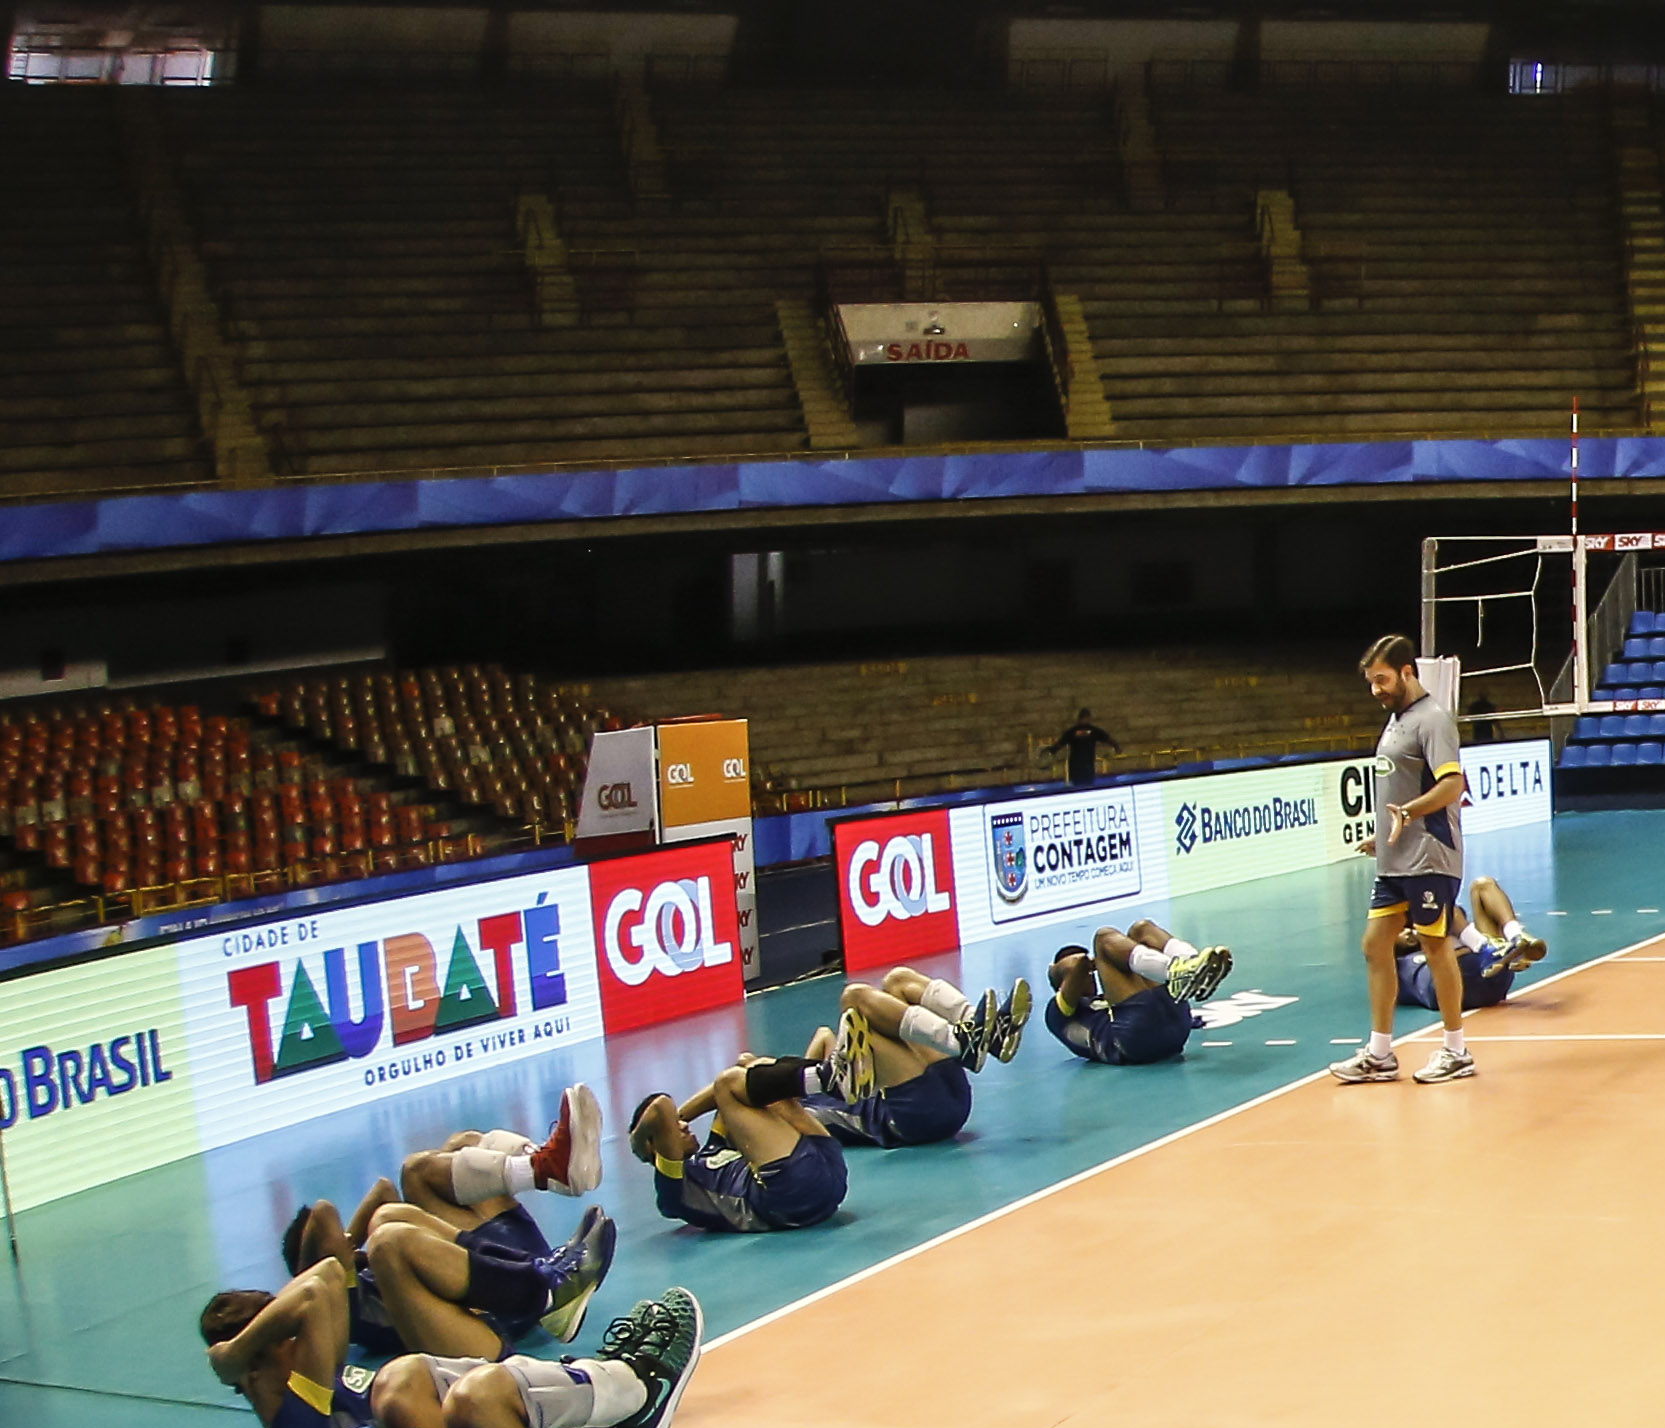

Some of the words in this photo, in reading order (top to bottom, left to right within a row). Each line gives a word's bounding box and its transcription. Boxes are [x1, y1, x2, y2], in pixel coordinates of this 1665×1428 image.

[887, 340, 969, 361] SAÍDA
[1585, 535, 1609, 549] SKY
[1618, 535, 1643, 547] SKY
[667, 764, 694, 783] GOL
[723, 759, 746, 780] GOL
[1480, 760, 1543, 801] DELTA
[598, 783, 637, 811] GOL
[1030, 804, 1129, 842] PREFEITURA
[1201, 807, 1250, 843] BANCO
[1253, 805, 1271, 834] DO
[1273, 797, 1318, 832] BRASIL
[1033, 831, 1132, 874] CONTAGEM
[849, 833, 950, 926] GOL
[223, 926, 289, 957] CIDADE
[299, 920, 319, 942] DE
[604, 876, 733, 986] GOL
[228, 891, 567, 1086] TAUBATÉ
[365, 1049, 446, 1086] ORGULHO
[455, 1041, 473, 1063] DE
[481, 1028, 526, 1053] VIVER
[533, 1016, 571, 1041] AQUI
[22, 1029, 173, 1120] BRASIL
